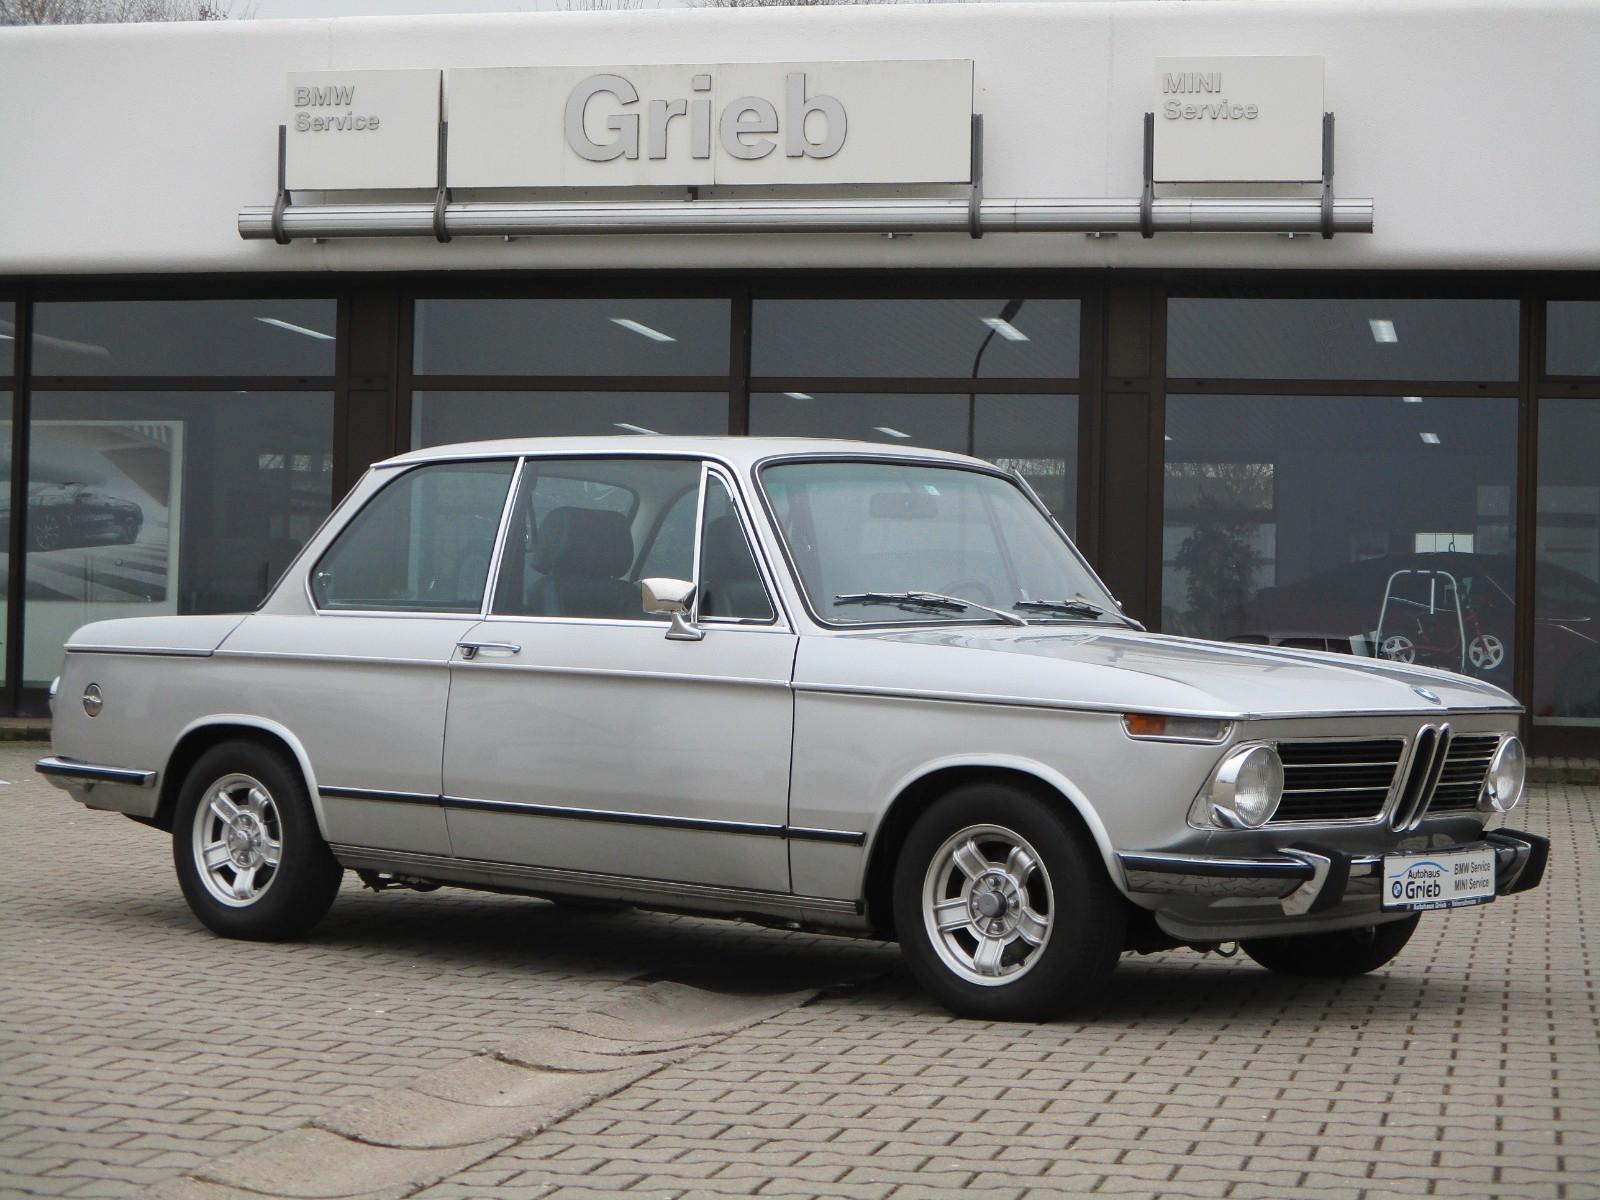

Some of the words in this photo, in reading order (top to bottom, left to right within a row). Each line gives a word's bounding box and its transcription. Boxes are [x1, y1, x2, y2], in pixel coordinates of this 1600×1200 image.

[1163, 72, 1222, 94] MINI
[294, 85, 355, 106] BMW
[564, 73, 848, 162] Grieb
[1165, 99, 1259, 120] Service
[295, 110, 380, 132] Service
[1408, 869, 1441, 879] Autohaus
[1454, 863, 1470, 875] BMW
[1471, 861, 1490, 873] Service
[1405, 880, 1441, 899] Grieb
[1454, 878, 1468, 891] MINI
[1469, 877, 1489, 890] Service
